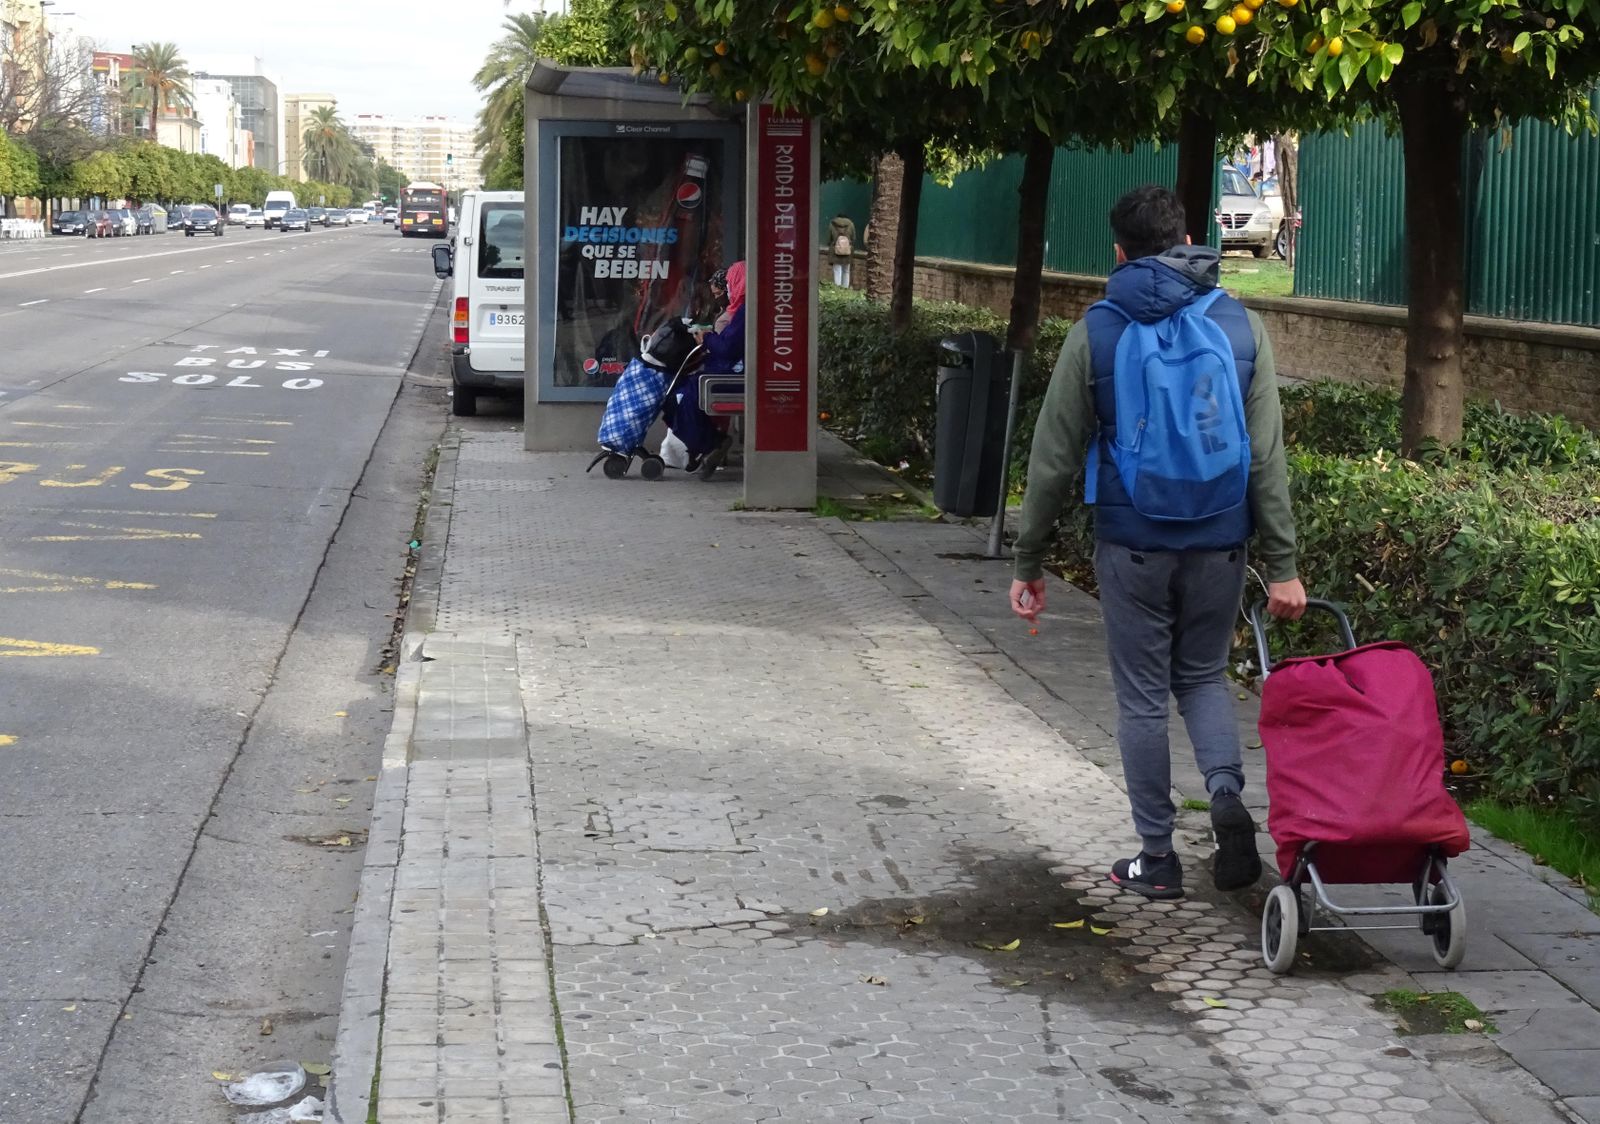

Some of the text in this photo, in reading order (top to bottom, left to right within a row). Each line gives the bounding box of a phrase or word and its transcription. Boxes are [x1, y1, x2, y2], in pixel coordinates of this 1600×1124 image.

[775, 145, 794, 197] RONDA
[580, 206, 628, 225] HAY
[774, 203, 795, 233] DEL
[564, 227, 678, 244] DECISIONES
[581, 245, 636, 258] QUE SE
[594, 260, 670, 279] BEBEN
[773, 240, 795, 356] TAMARGUILLO
[497, 315, 525, 325] 9362
[191, 344, 330, 357] TAXI
[174, 357, 315, 370] BUS
[773, 362, 793, 372] 2
[118, 372, 324, 390] SOLO
